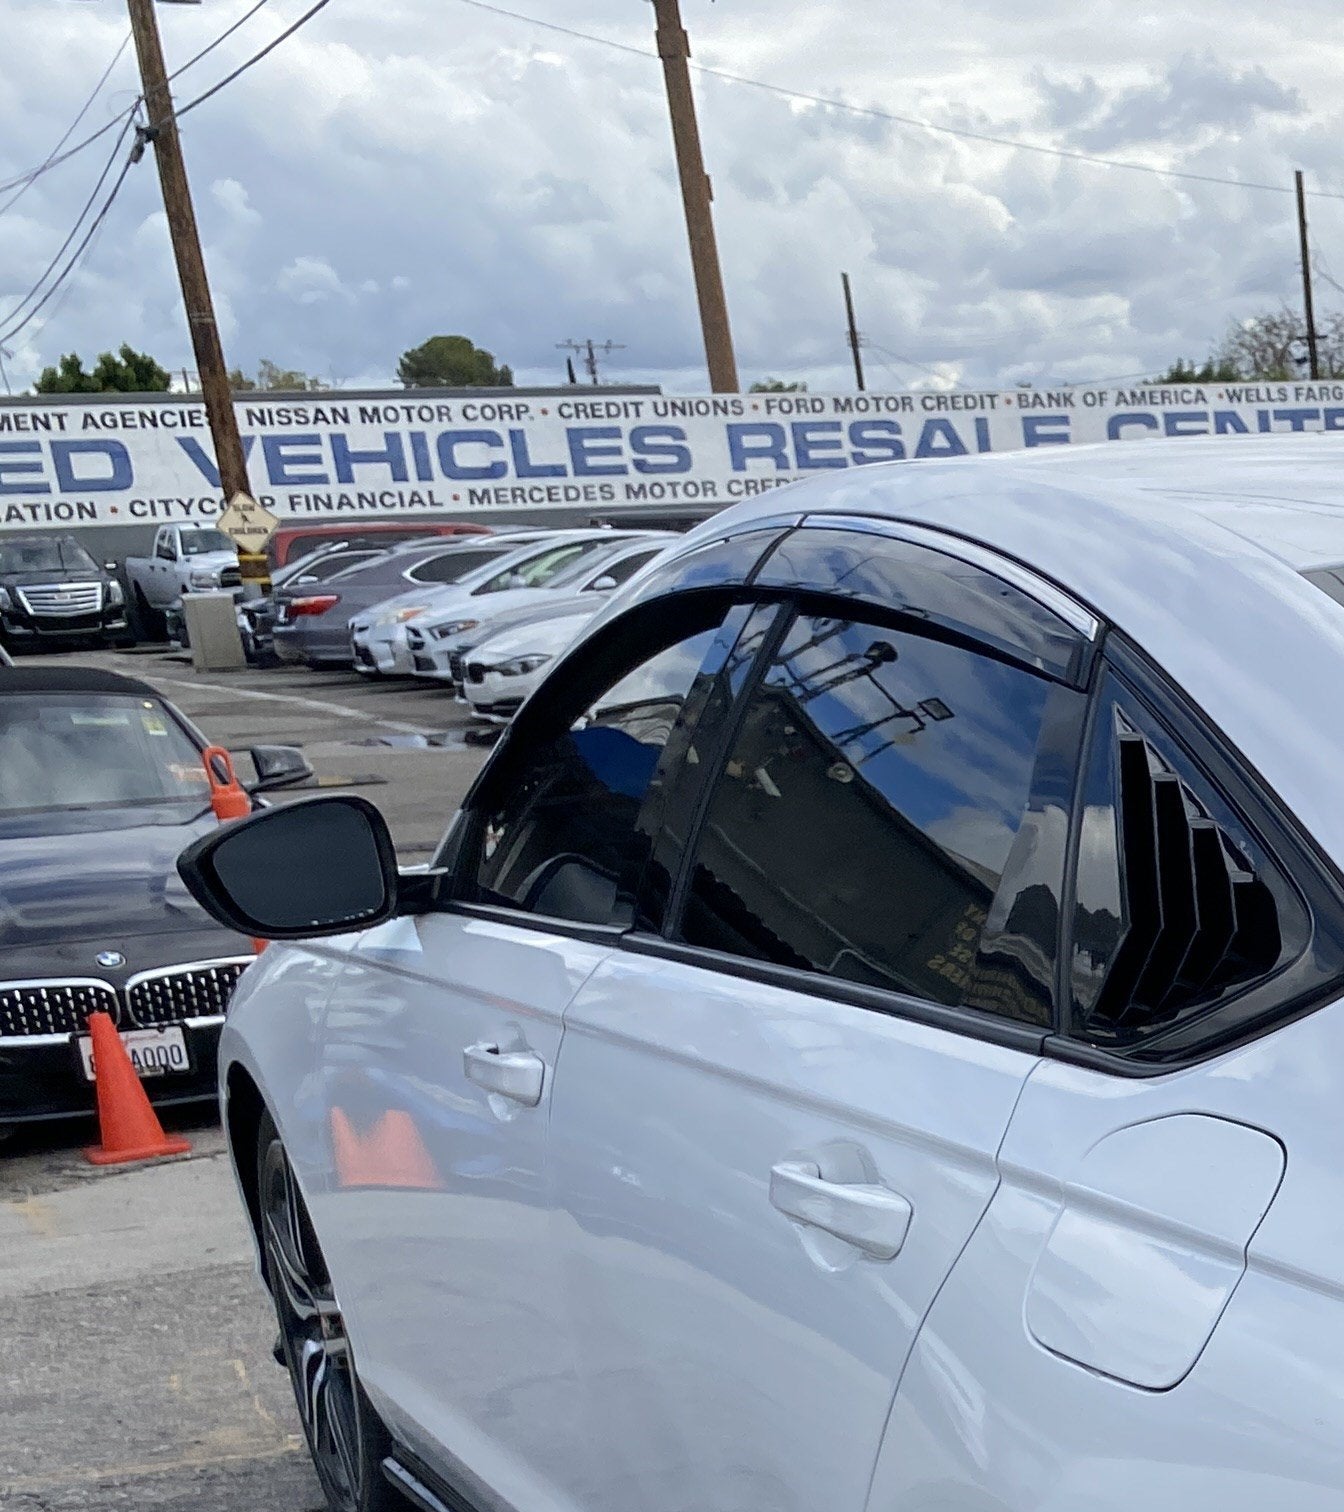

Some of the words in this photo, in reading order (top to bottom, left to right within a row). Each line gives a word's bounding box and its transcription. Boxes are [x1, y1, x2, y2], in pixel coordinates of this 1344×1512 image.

[82, 410, 209, 430] AGENCIE
[246, 406, 350, 427] NISSAN
[360, 404, 452, 425] MOTOR
[558, 401, 643, 420] CREDIT
[653, 399, 744, 418] UNIONS
[765, 397, 825, 415] FORD
[833, 396, 914, 414] MOTOR
[921, 394, 999, 412] CREDIT
[1017, 391, 1076, 409] BANK
[1082, 390, 1110, 408] OF
[1114, 388, 1209, 406] AMERICA
[1225, 387, 1288, 403] WELLS
[175, 425, 692, 489] VEHICLES
[726, 416, 1071, 473] RESALE
[0, 501, 98, 523] ATION
[129, 496, 275, 517] CITYCP
[289, 489, 444, 512] FINANCIAL
[468, 484, 616, 505] MERCEDES
[626, 480, 718, 500] MOTOR
